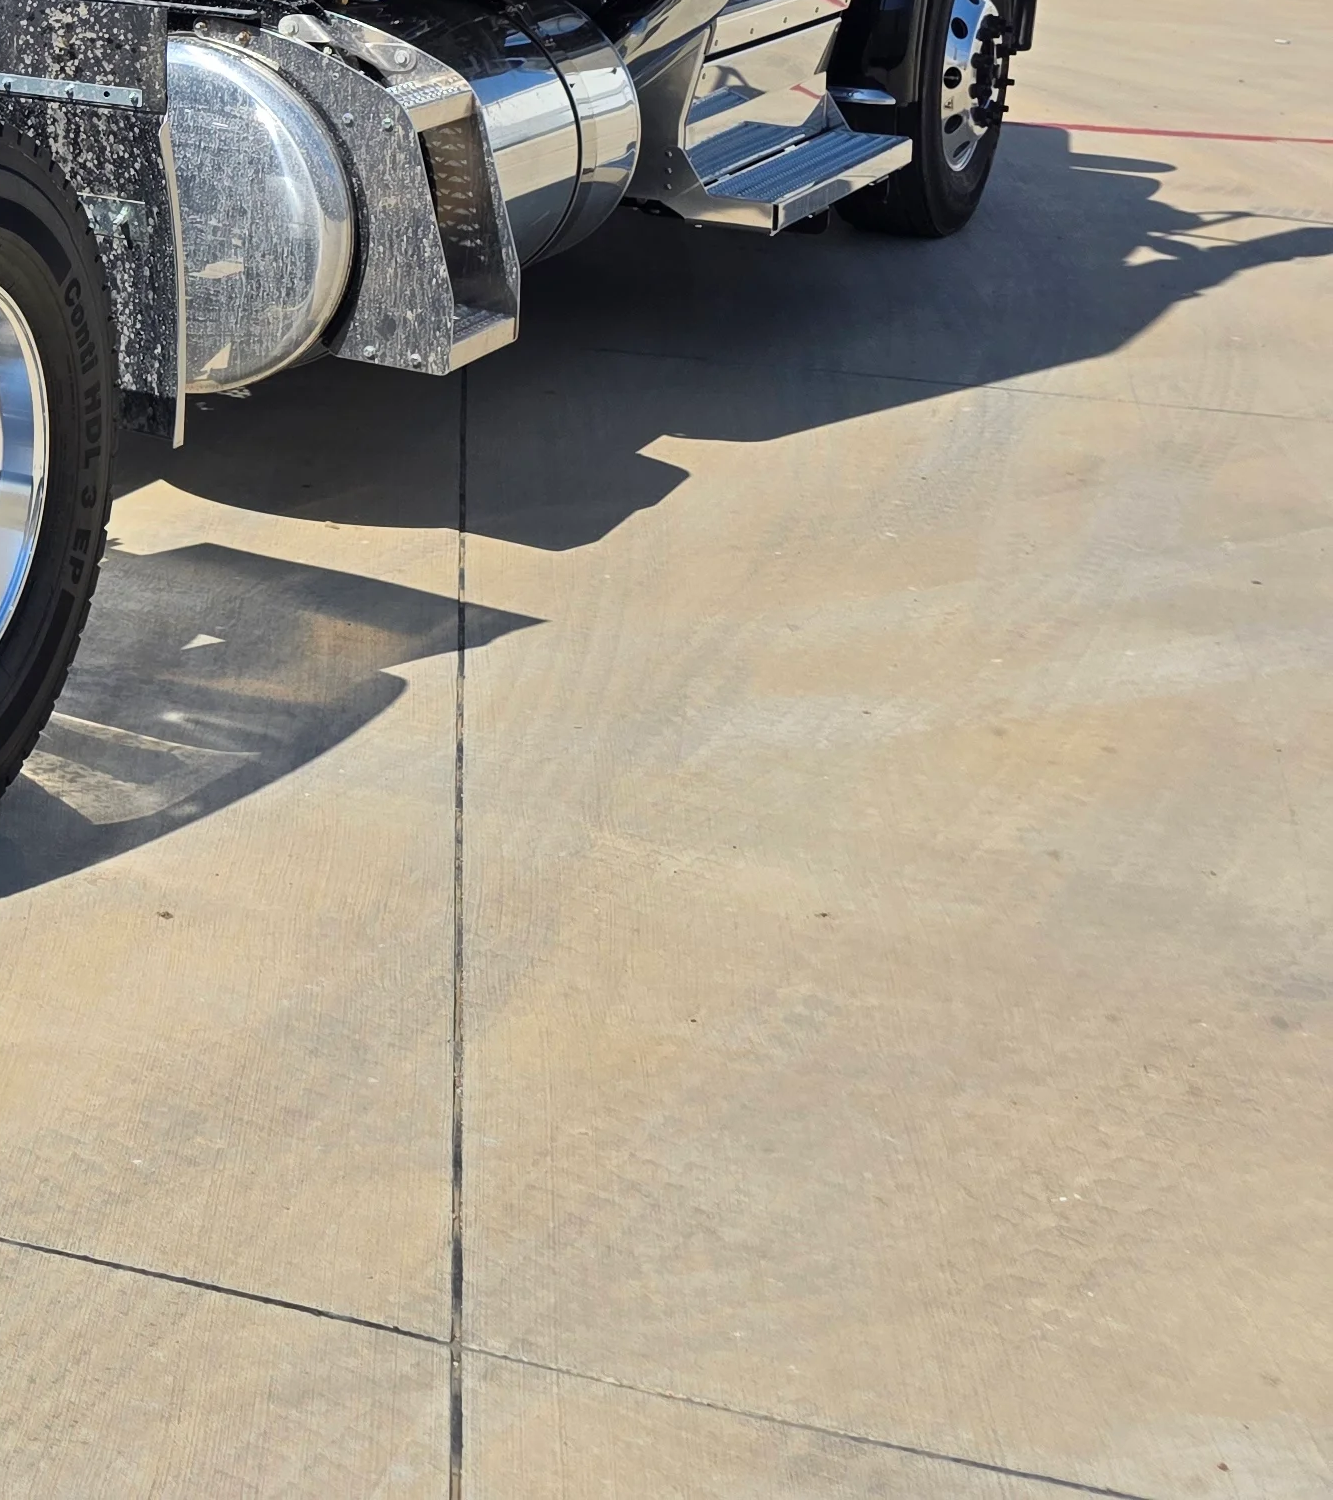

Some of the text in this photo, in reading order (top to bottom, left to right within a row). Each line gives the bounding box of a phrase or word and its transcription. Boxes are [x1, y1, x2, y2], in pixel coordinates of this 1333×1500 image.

[65, 277, 102, 587] Conti HDL 3 EP
